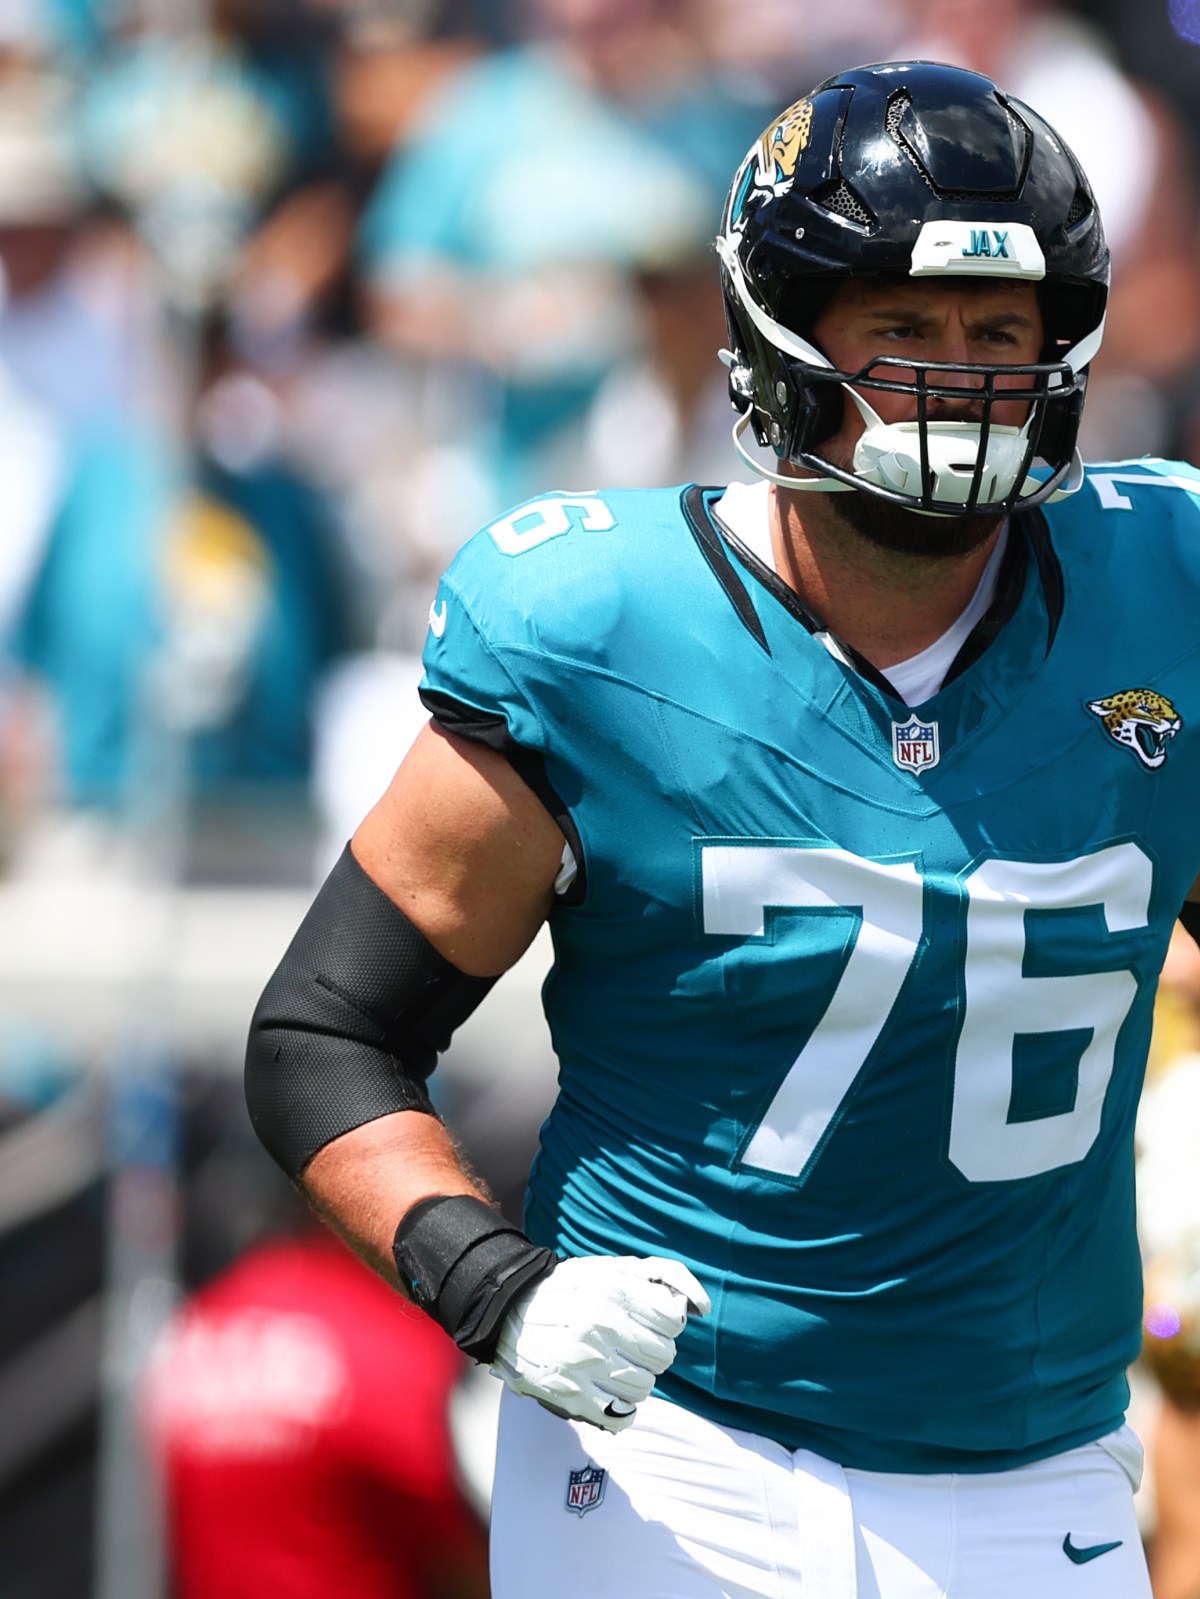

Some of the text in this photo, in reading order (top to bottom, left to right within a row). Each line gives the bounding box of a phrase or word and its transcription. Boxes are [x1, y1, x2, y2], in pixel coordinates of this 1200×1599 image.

[962, 230, 1008, 258] JAX
[488, 490, 616, 556] 6
[900, 742, 932, 764] NFL
[701, 841, 1154, 1184] 76
[570, 1484, 597, 1505] NFL
